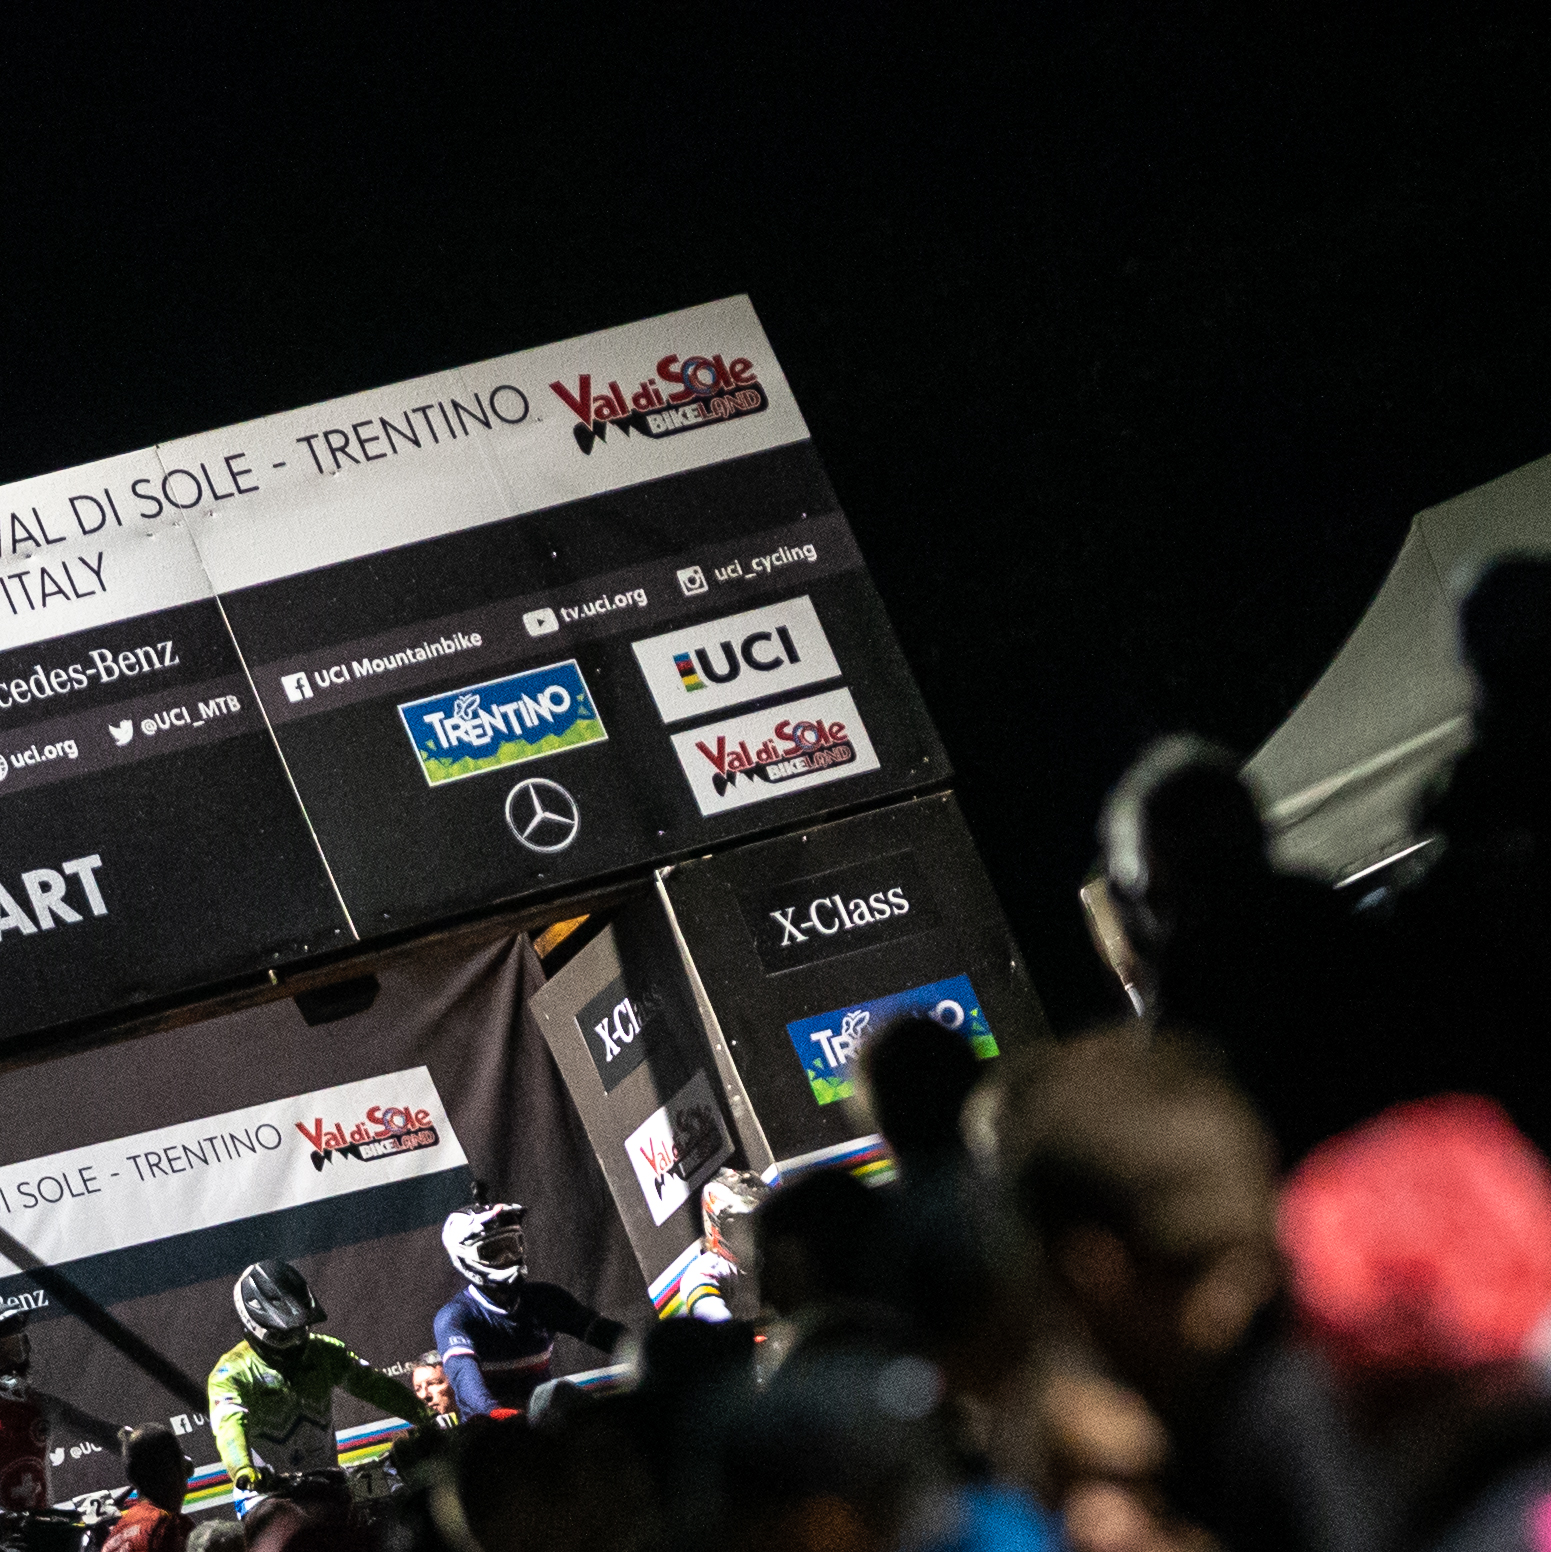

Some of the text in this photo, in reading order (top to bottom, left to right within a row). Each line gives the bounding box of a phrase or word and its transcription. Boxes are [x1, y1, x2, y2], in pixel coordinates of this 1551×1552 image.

[69, 488, 122, 536] DI
[132, 452, 260, 520] SOLE
[296, 384, 530, 475] TRENTINO
[714, 541, 818, 583] uci_cycling
[559, 586, 648, 622] tv.uci.org
[314, 630, 482, 689] UCI Mountainbike
[694, 624, 802, 684] UCI
[140, 694, 241, 736] @UCI_MTB
[423, 685, 570, 749] TRENTINO
[10, 737, 78, 770] uci.org
[771, 881, 911, 948] X-Class
[17, 1167, 101, 1209] SOLE
[127, 1123, 282, 1182] TRENTINO
